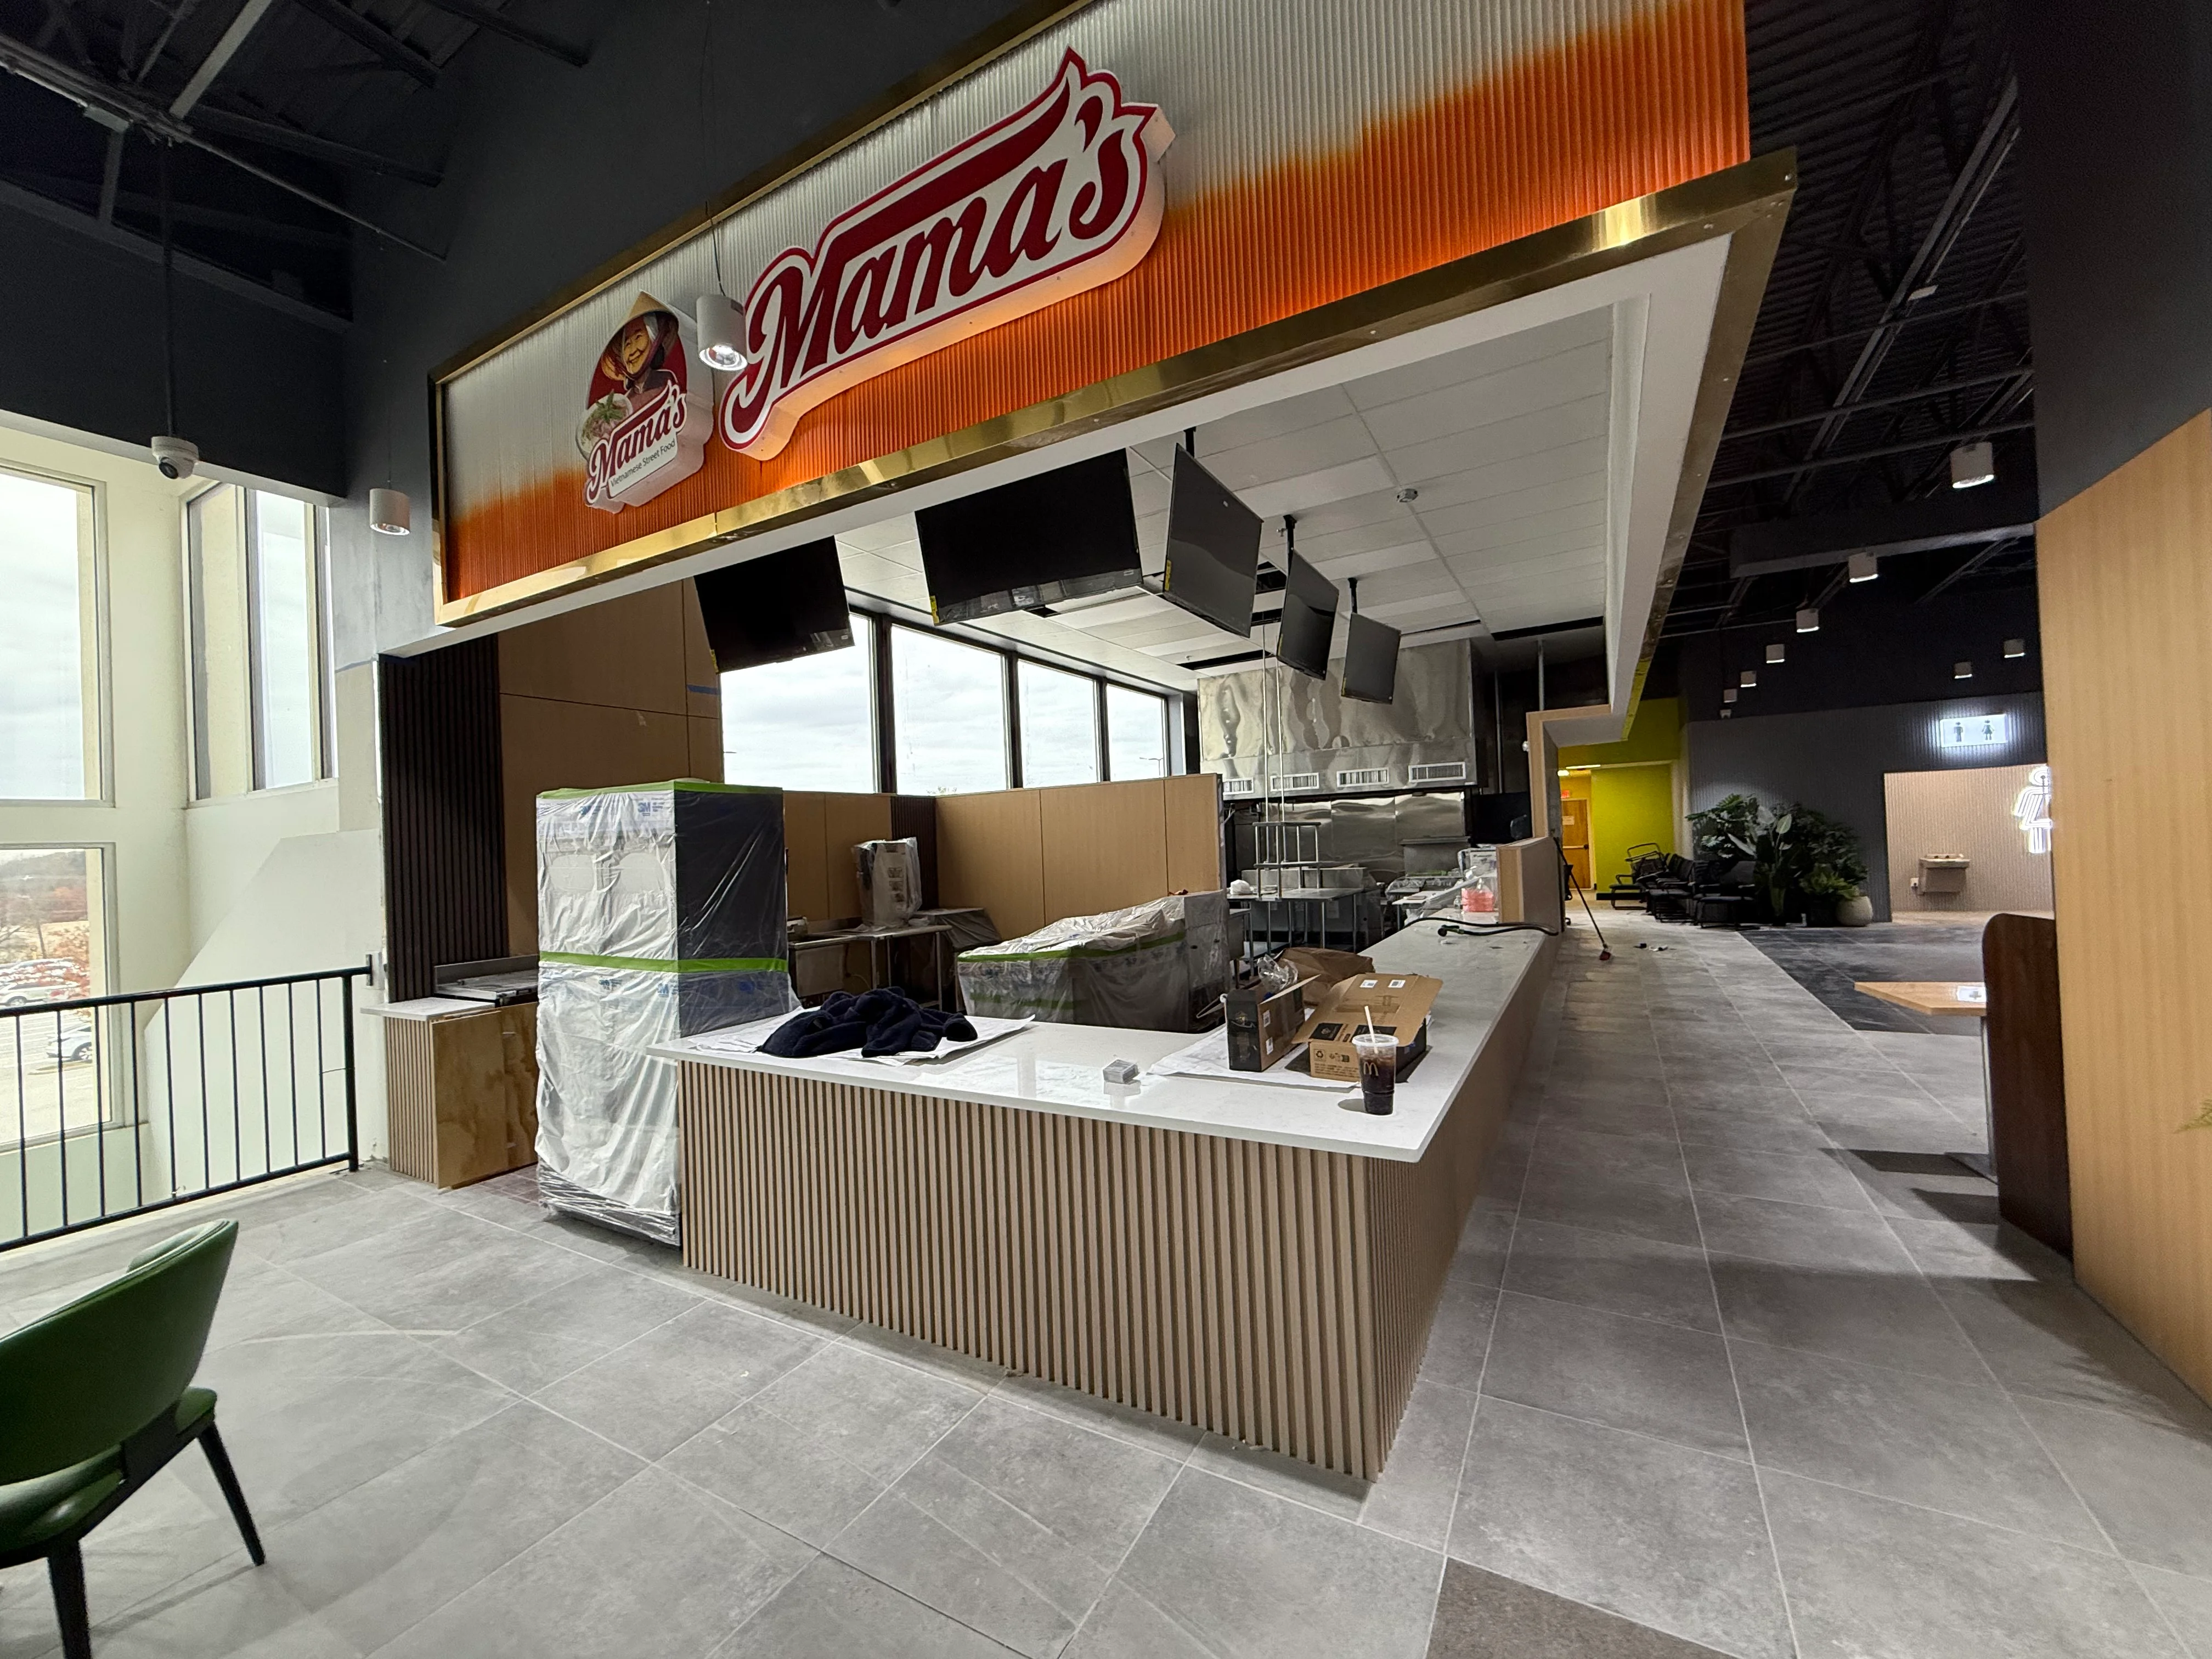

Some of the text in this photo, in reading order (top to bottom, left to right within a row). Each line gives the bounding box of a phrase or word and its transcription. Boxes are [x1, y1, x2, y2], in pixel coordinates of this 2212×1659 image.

[731, 77, 1129, 433] Mama's
[589, 386, 685, 500] Mama's
[610, 439, 675, 487] Vietnamese Street Food
